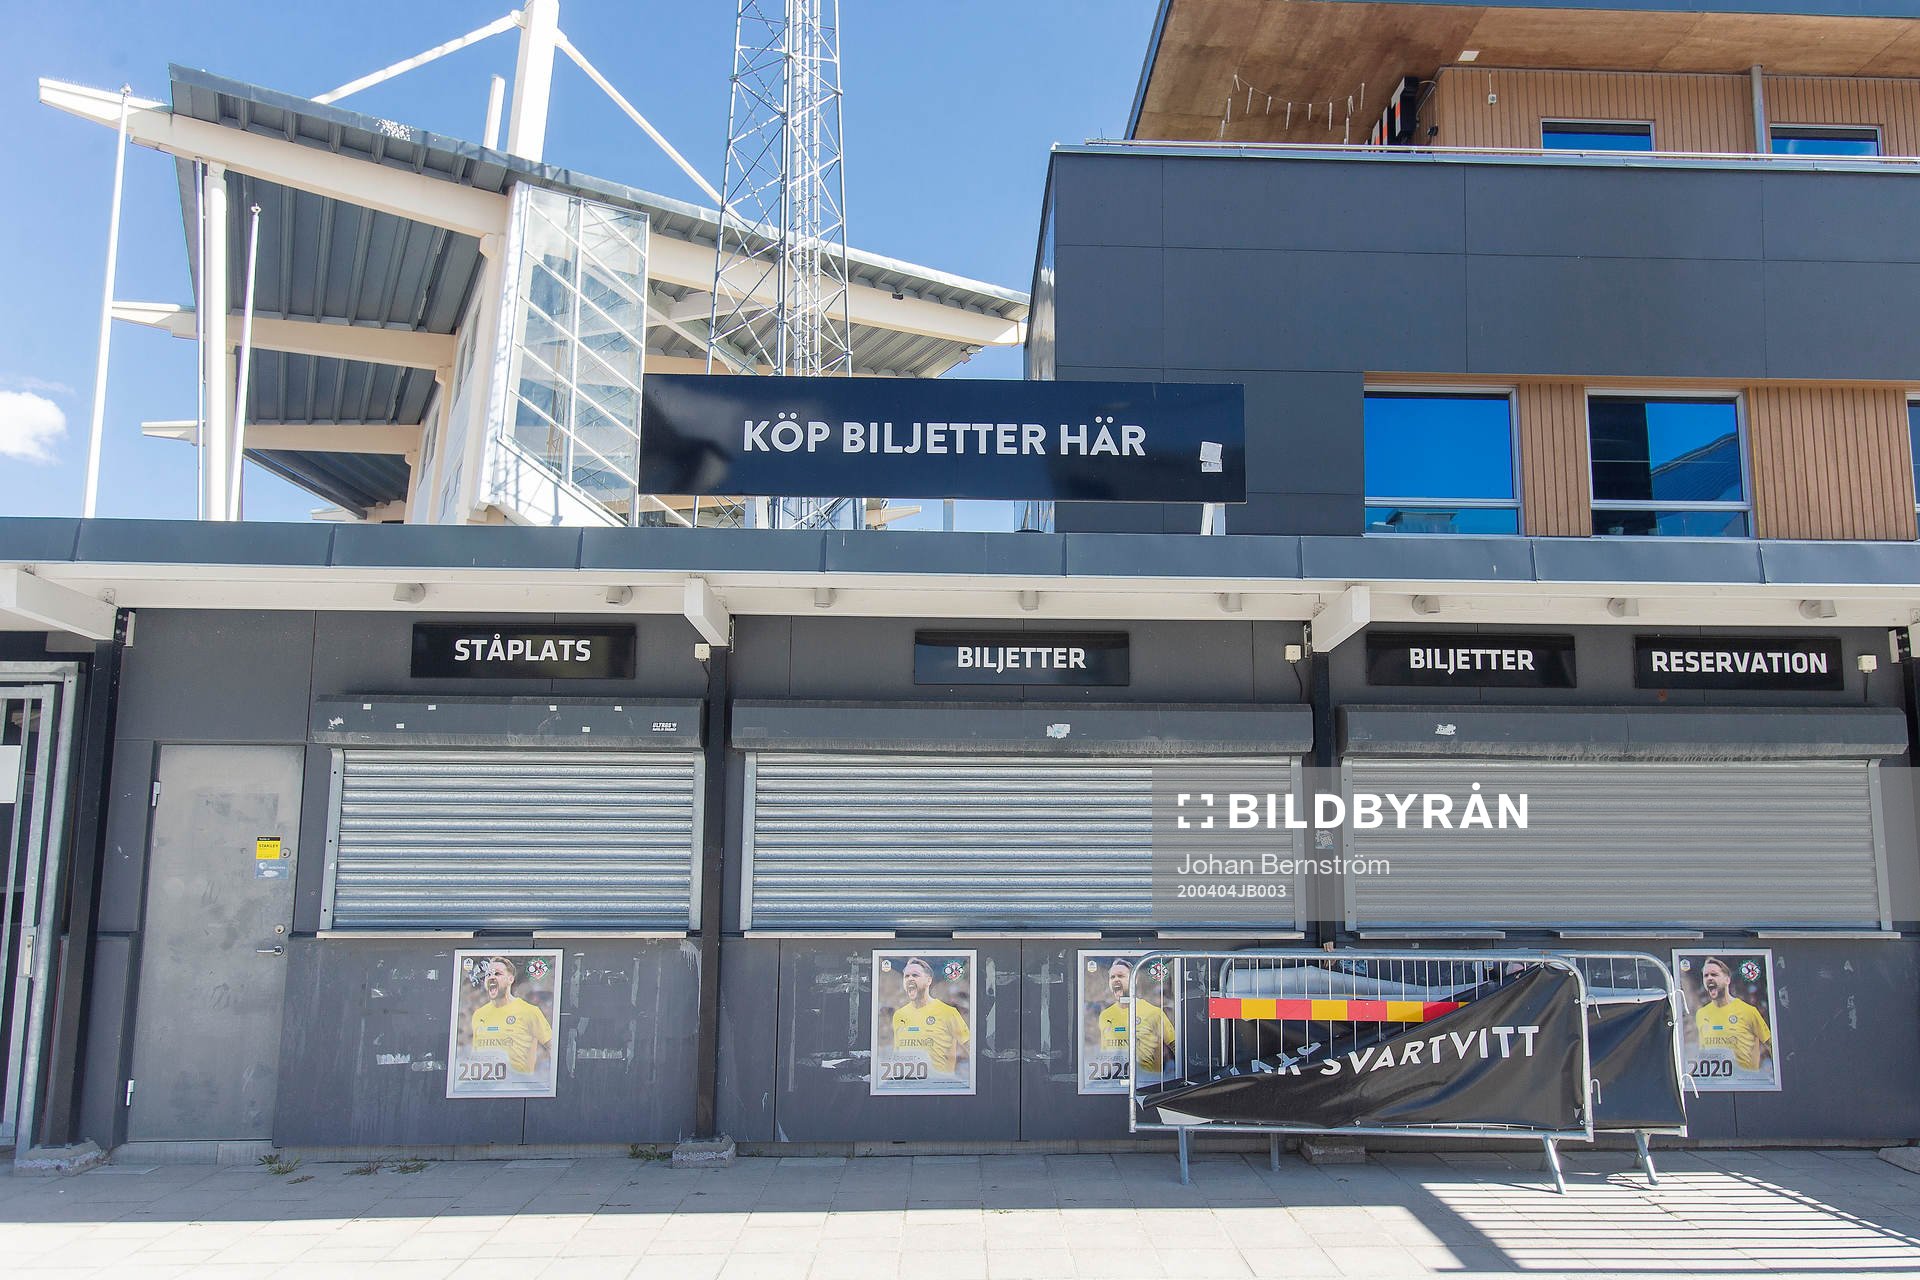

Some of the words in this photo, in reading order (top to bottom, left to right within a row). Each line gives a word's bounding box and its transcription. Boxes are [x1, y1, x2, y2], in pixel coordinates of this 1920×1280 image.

[743, 412, 831, 453] KÖP
[842, 421, 1047, 455] BILJETTER
[1060, 416, 1147, 456] HÄR
[454, 633, 592, 662] STÅPLATS
[957, 645, 1087, 674] BILJETTER
[1409, 647, 1535, 675] BILJETTER
[1651, 650, 1829, 675] RESERVATION
[1320, 1025, 1541, 1077] SVARTVITT
[458, 1062, 507, 1081] 2020
[880, 1062, 928, 1081] 2020
[1088, 1062, 1131, 1081] 2020
[1687, 1059, 1733, 1077] 2020
